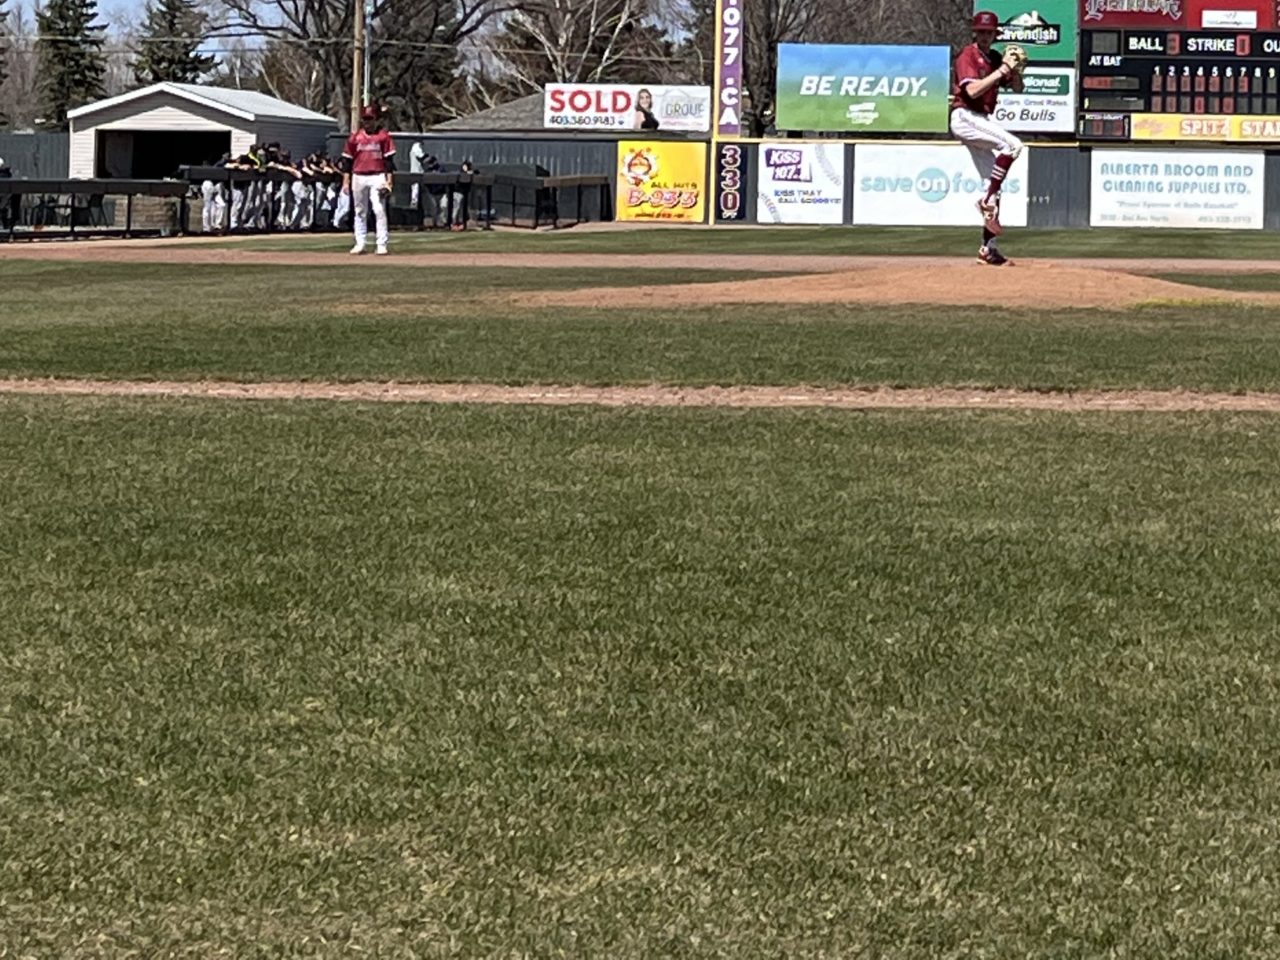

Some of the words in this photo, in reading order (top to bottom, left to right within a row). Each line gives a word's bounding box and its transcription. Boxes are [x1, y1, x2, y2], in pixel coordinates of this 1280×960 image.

[1128, 36, 1163, 50] BALL
[1187, 38, 1235, 51] STRIKE
[1089, 55, 1102, 66] AT
[1103, 55, 1122, 66] BAT
[1168, 66, 1176, 76] 2
[1183, 66, 1190, 76] 3
[1197, 67, 1204, 76] 4
[1211, 67, 1219, 77] 5
[1225, 67, 1233, 77] 6
[1239, 67, 1247, 77] 7
[800, 76, 836, 95] BE
[839, 77, 927, 96] READY.
[550, 90, 632, 113] SOLD
[996, 108, 1015, 120] Go
[1020, 109, 1056, 121] Bulls
[1181, 120, 1228, 136] SPITZ
[1101, 163, 1159, 176] ALBERTA
[1164, 164, 1218, 176] BROOM
[1224, 165, 1254, 177] AND
[720, 144, 741, 212] 330
[860, 177, 913, 192] save
[917, 178, 946, 191] on
[1103, 180, 1164, 193] CLEANING
[1168, 181, 1220, 194] SUPPLIES
[1224, 182, 1251, 194] LTD.
